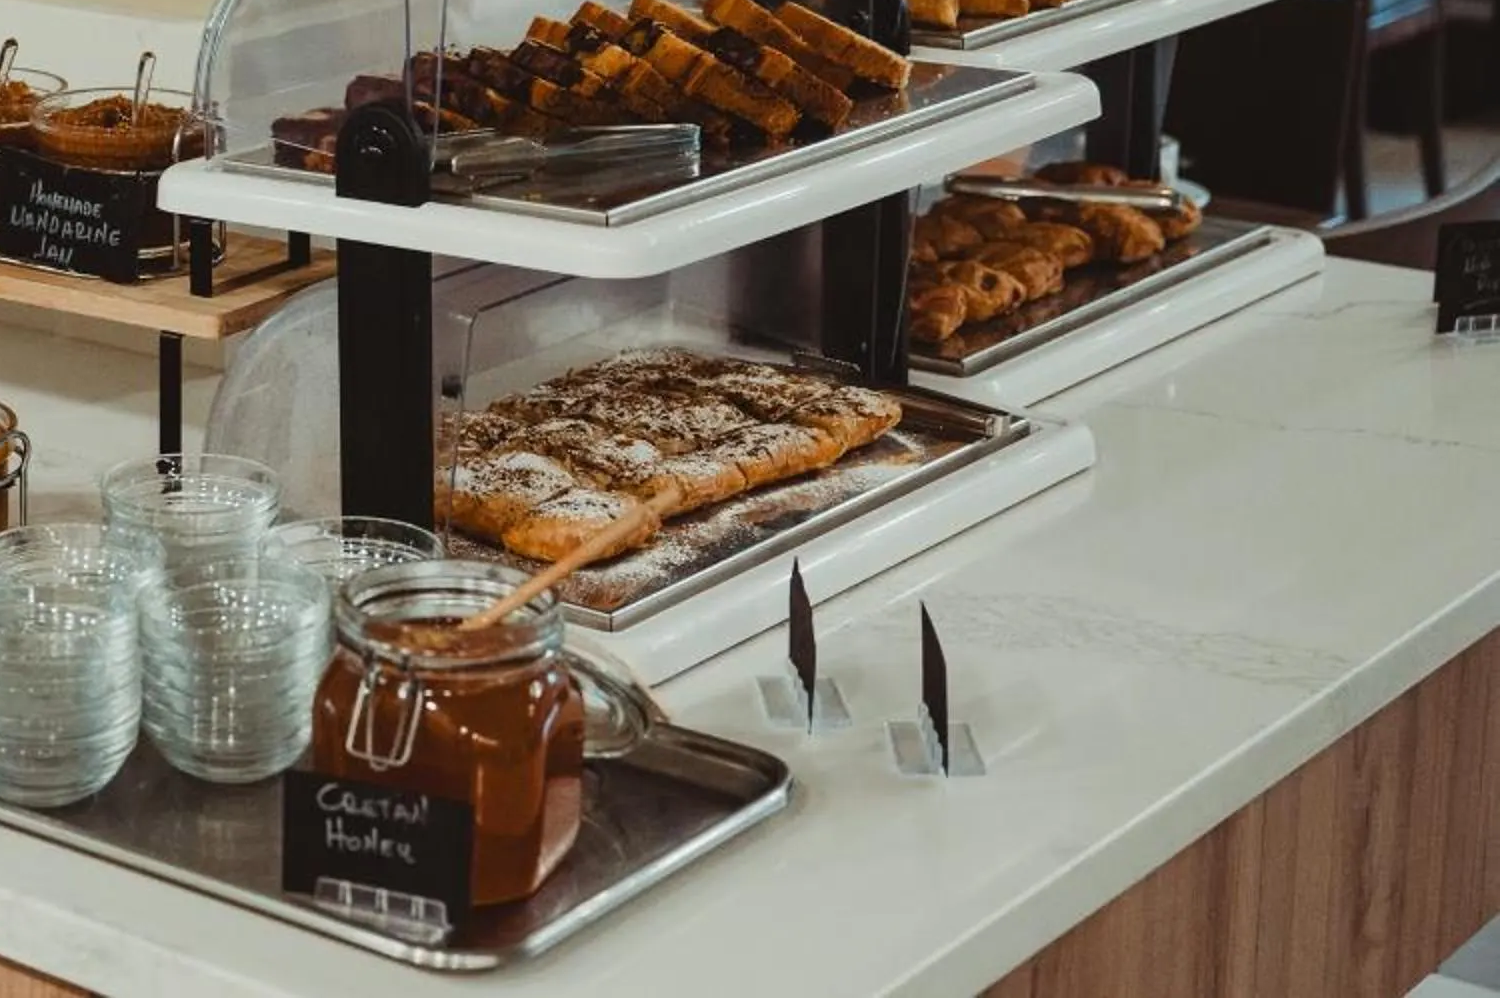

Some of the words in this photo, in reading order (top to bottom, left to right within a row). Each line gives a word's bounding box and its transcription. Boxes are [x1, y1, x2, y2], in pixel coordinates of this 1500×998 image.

[30, 178, 103, 218] HOMEMADE
[33, 235, 73, 265] JAM
[316, 783, 428, 824] CRETAN
[326, 816, 416, 865] HONEY
